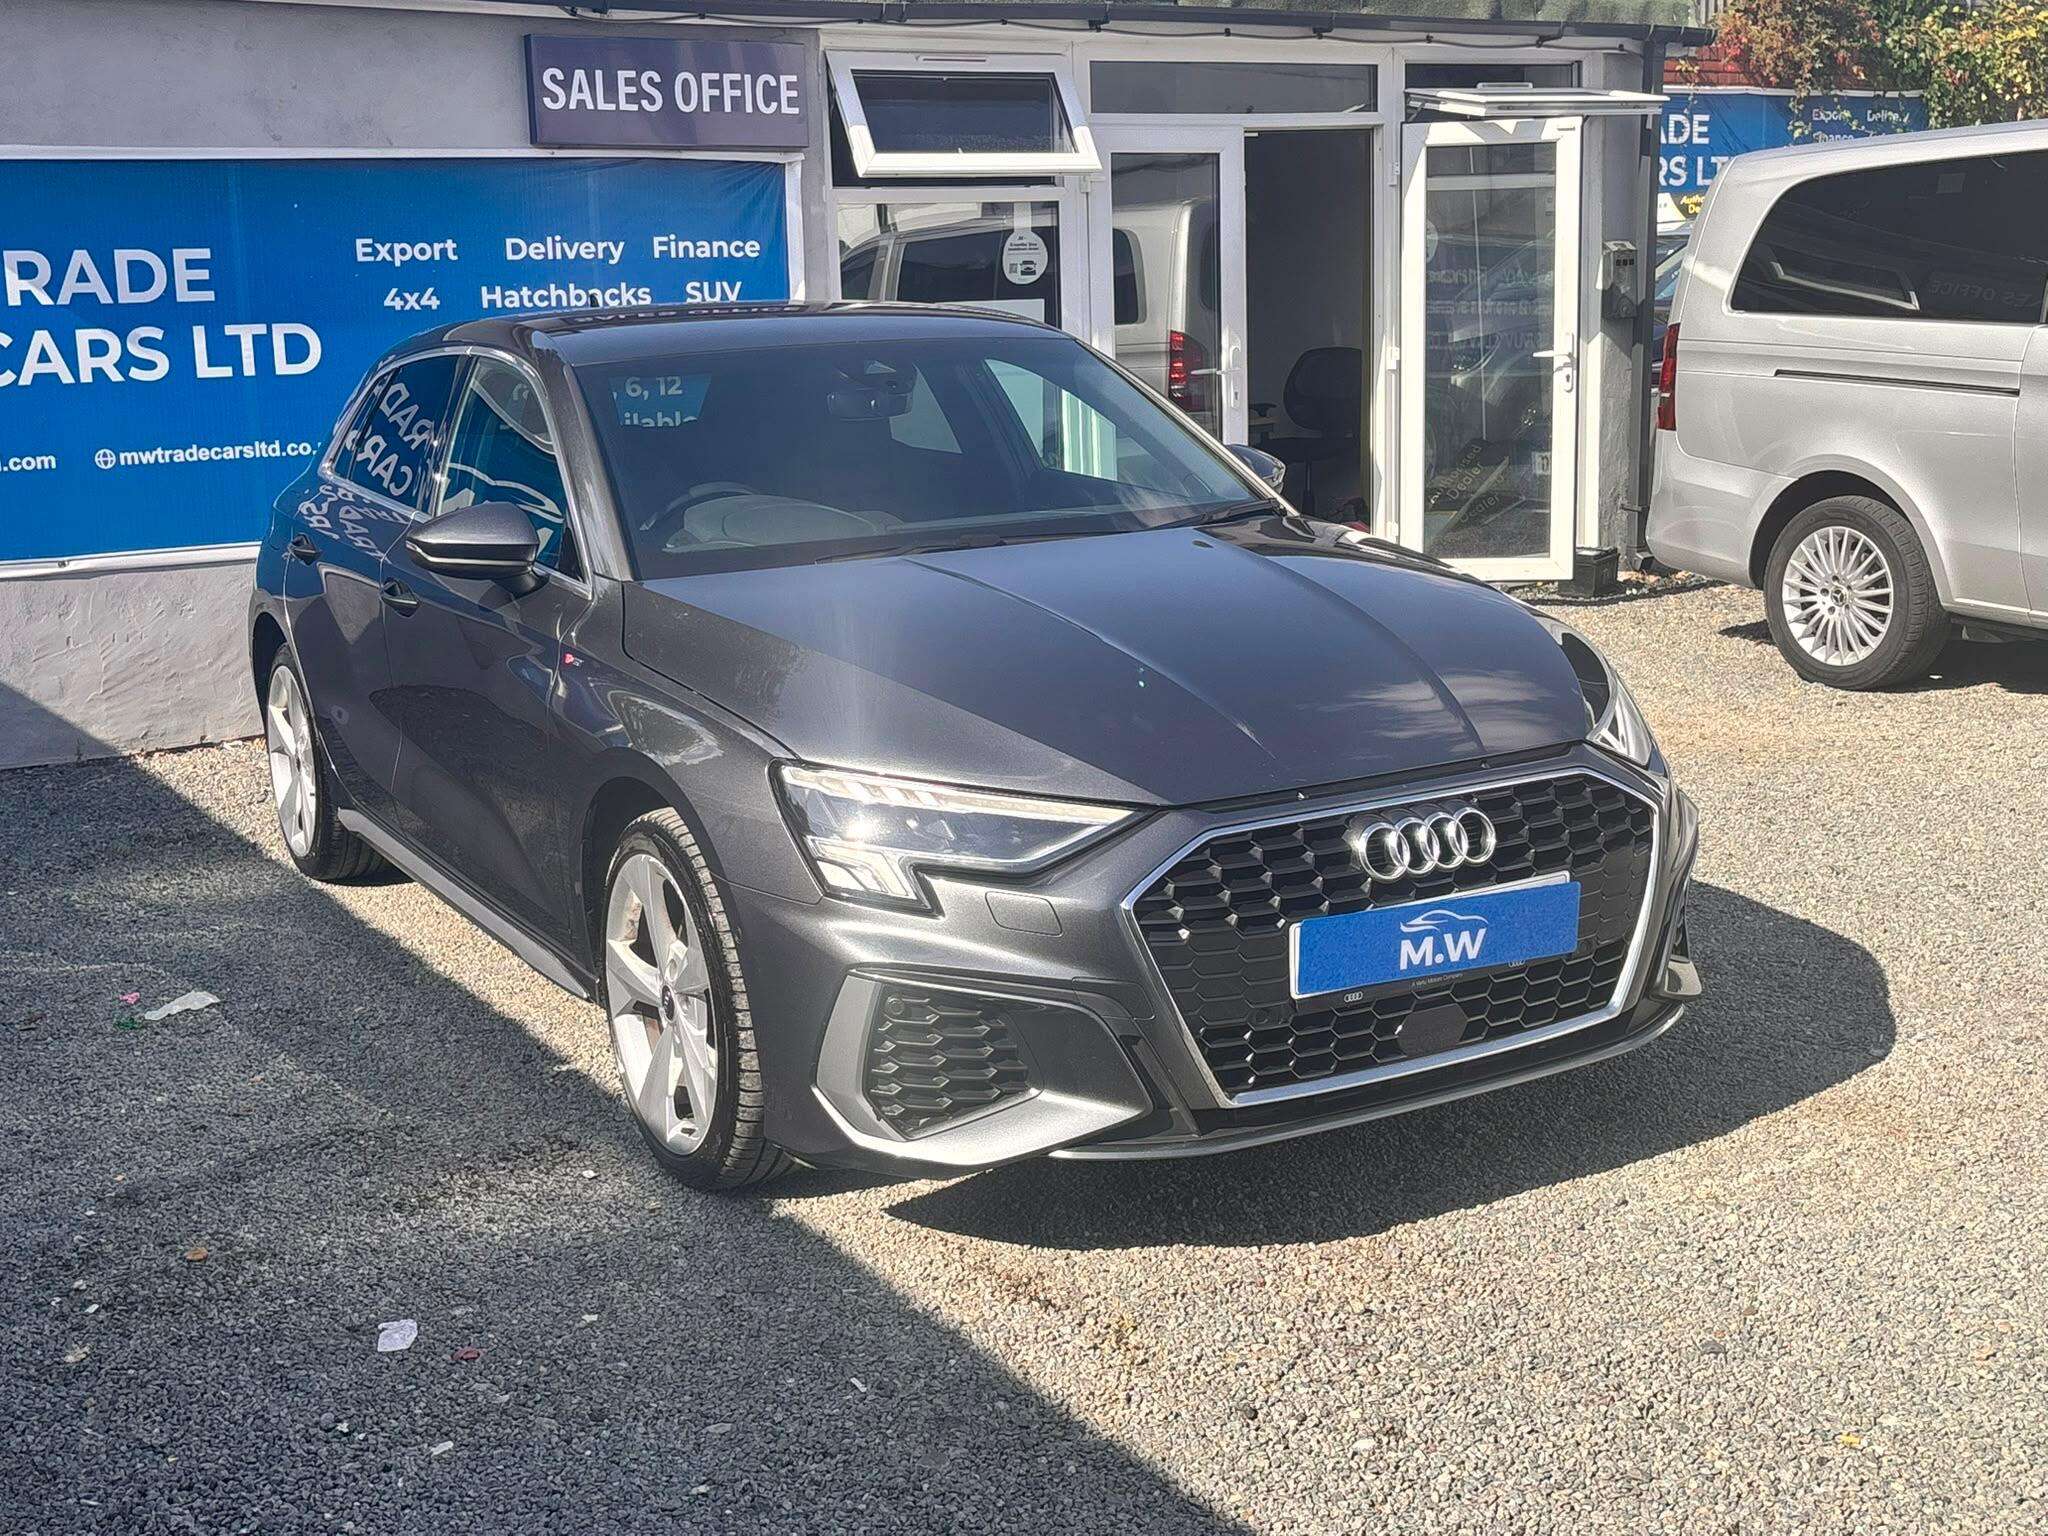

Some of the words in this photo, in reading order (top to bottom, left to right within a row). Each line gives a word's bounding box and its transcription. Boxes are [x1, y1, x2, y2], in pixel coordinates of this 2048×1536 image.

[542, 67, 664, 112] SALES
[674, 71, 800, 115] OFFICE
[1696, 155, 1733, 186] LT
[354, 237, 459, 267] Export
[504, 235, 626, 265] Delivery
[652, 233, 761, 259] Finance
[2, 247, 216, 307] RADE
[382, 287, 441, 311] 4x4
[685, 280, 743, 304] SUV
[192, 322, 322, 379] LTD
[656, 375, 684, 397] 12
[0, 454, 57, 472] .com
[119, 439, 321, 467] mwtradecarsltd.co.
[1400, 927, 1488, 971] M.W
